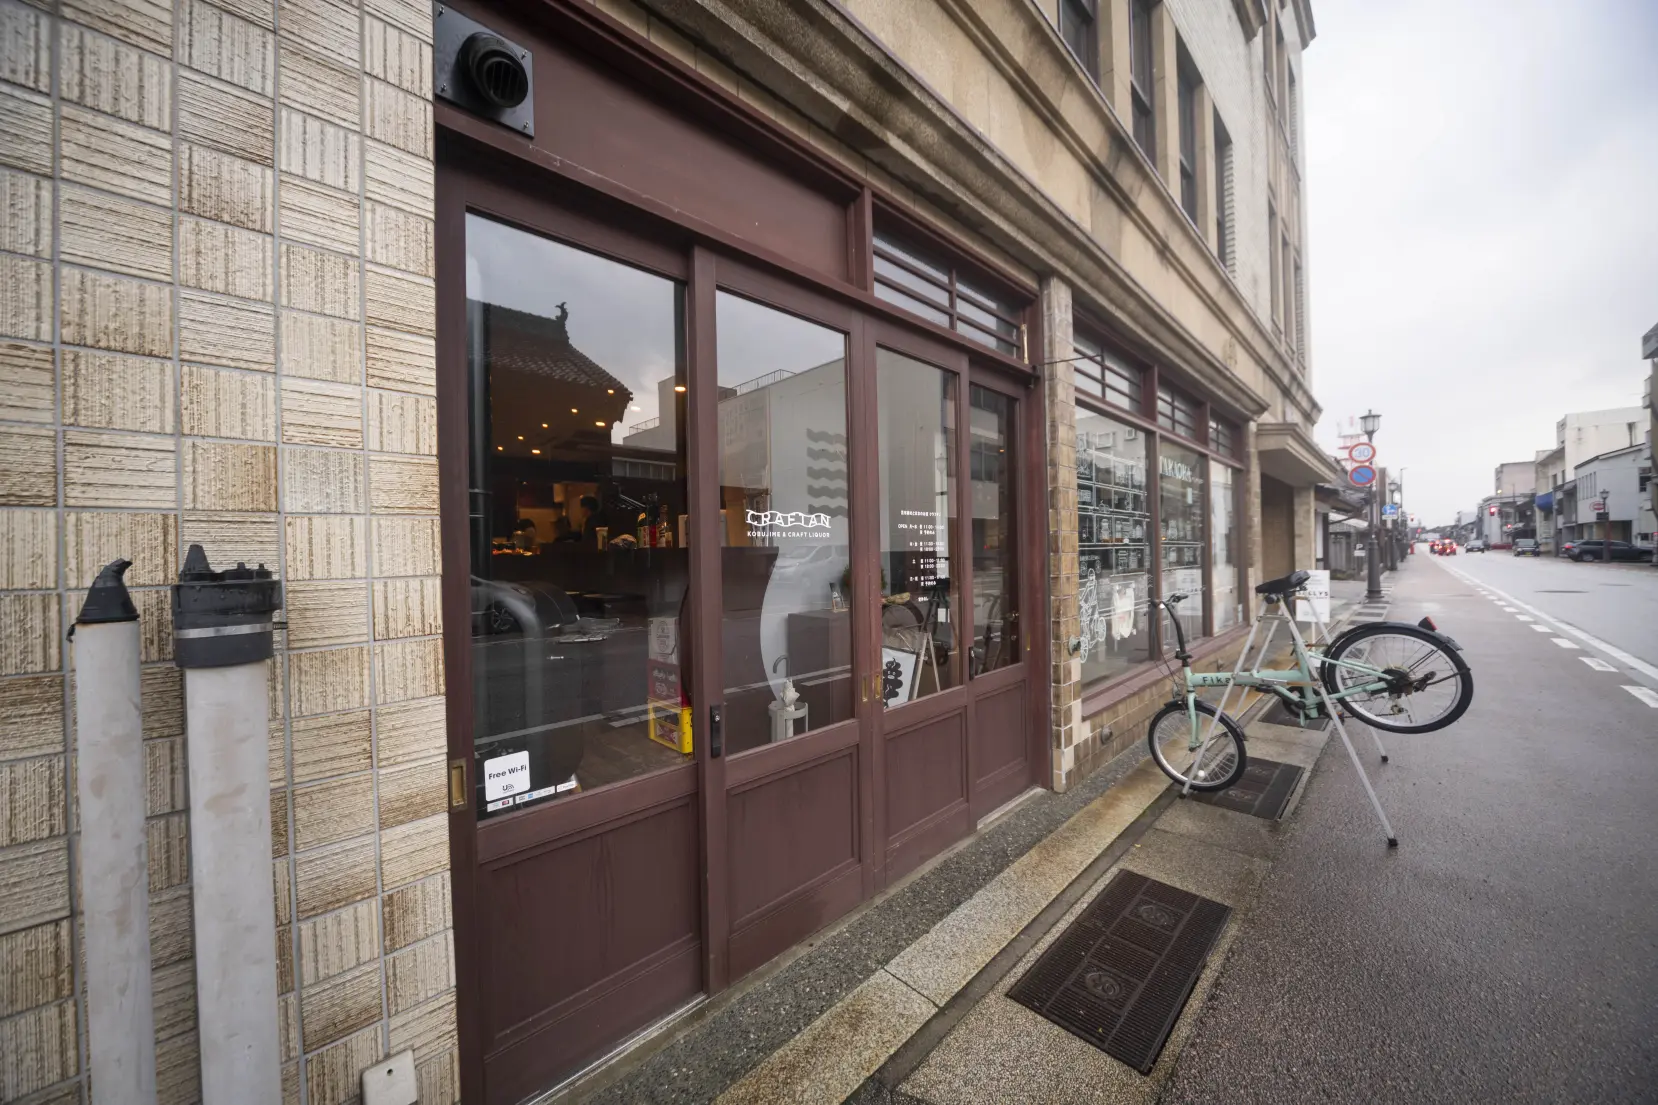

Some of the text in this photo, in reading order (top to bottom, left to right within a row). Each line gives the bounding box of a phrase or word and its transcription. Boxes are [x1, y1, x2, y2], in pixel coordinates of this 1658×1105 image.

[1354, 448, 1370, 457] 30
[488, 764, 527, 780] Free Wi-Fi
